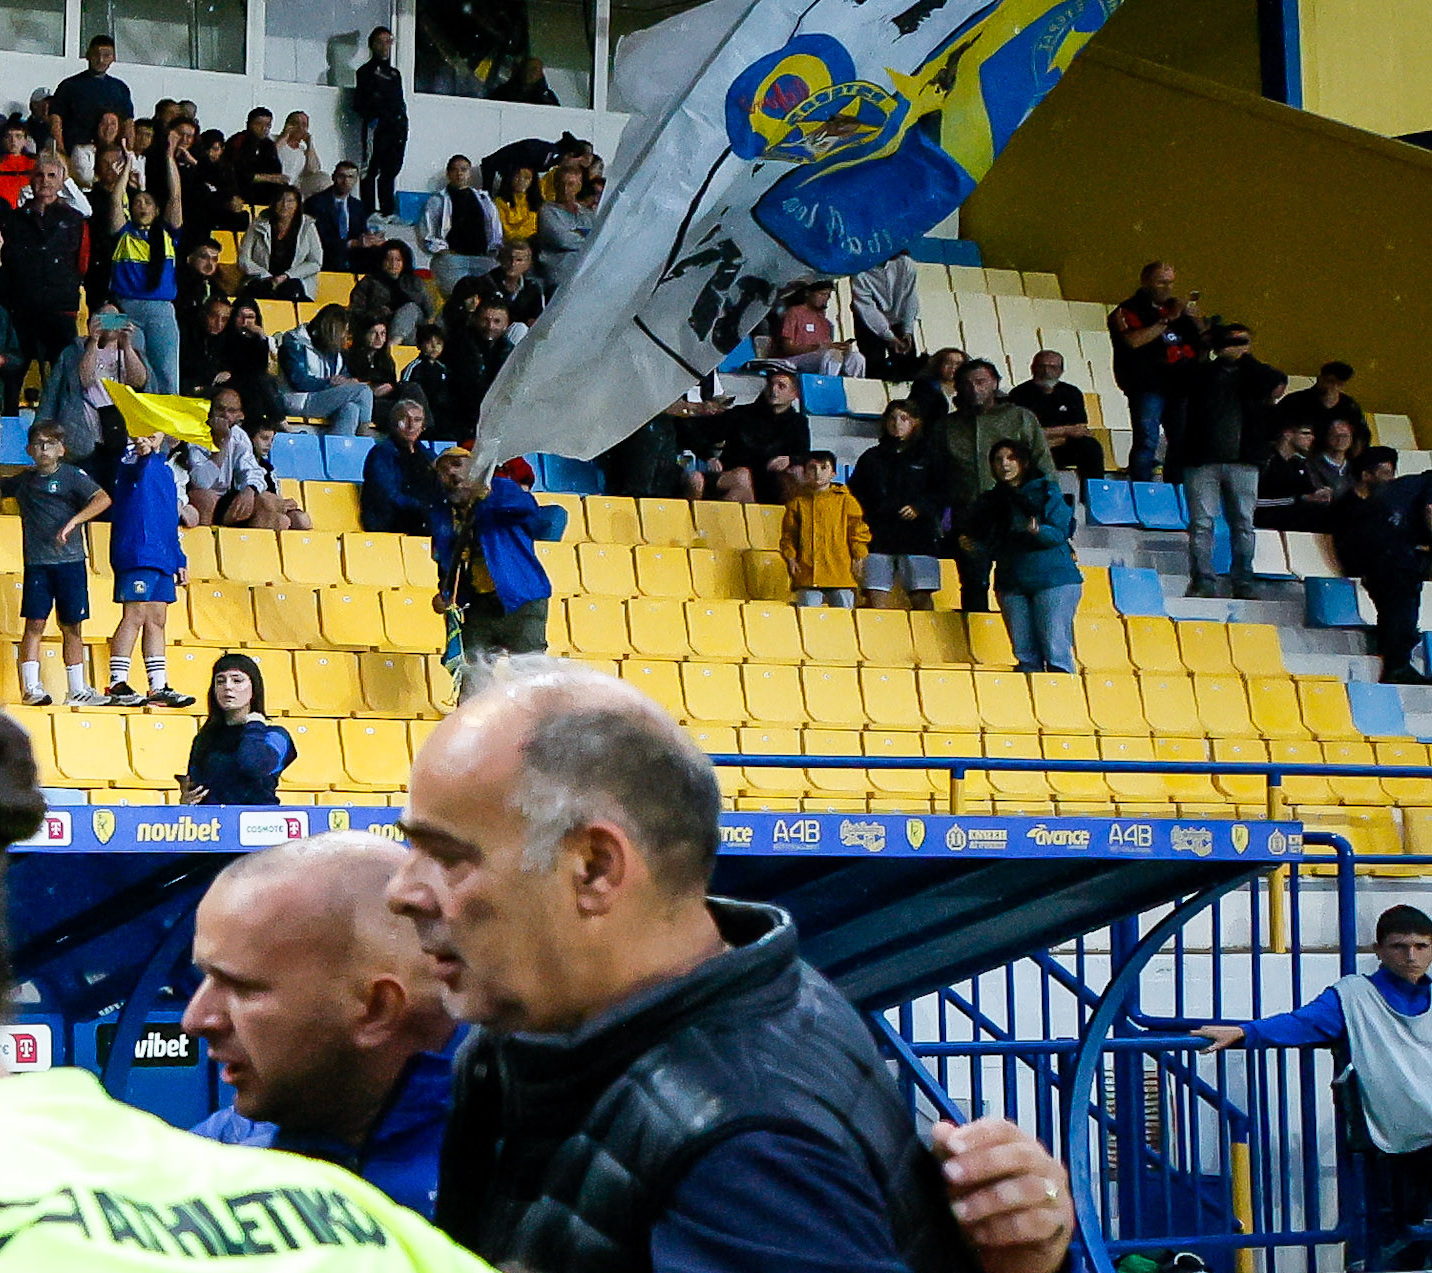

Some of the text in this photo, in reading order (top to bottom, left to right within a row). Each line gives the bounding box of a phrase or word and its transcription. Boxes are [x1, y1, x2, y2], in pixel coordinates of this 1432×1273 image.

[136, 815, 222, 844] novibet
[246, 824, 284, 834] COSMOTE
[773, 819, 821, 844] A4B
[1108, 823, 1154, 847] A4B
